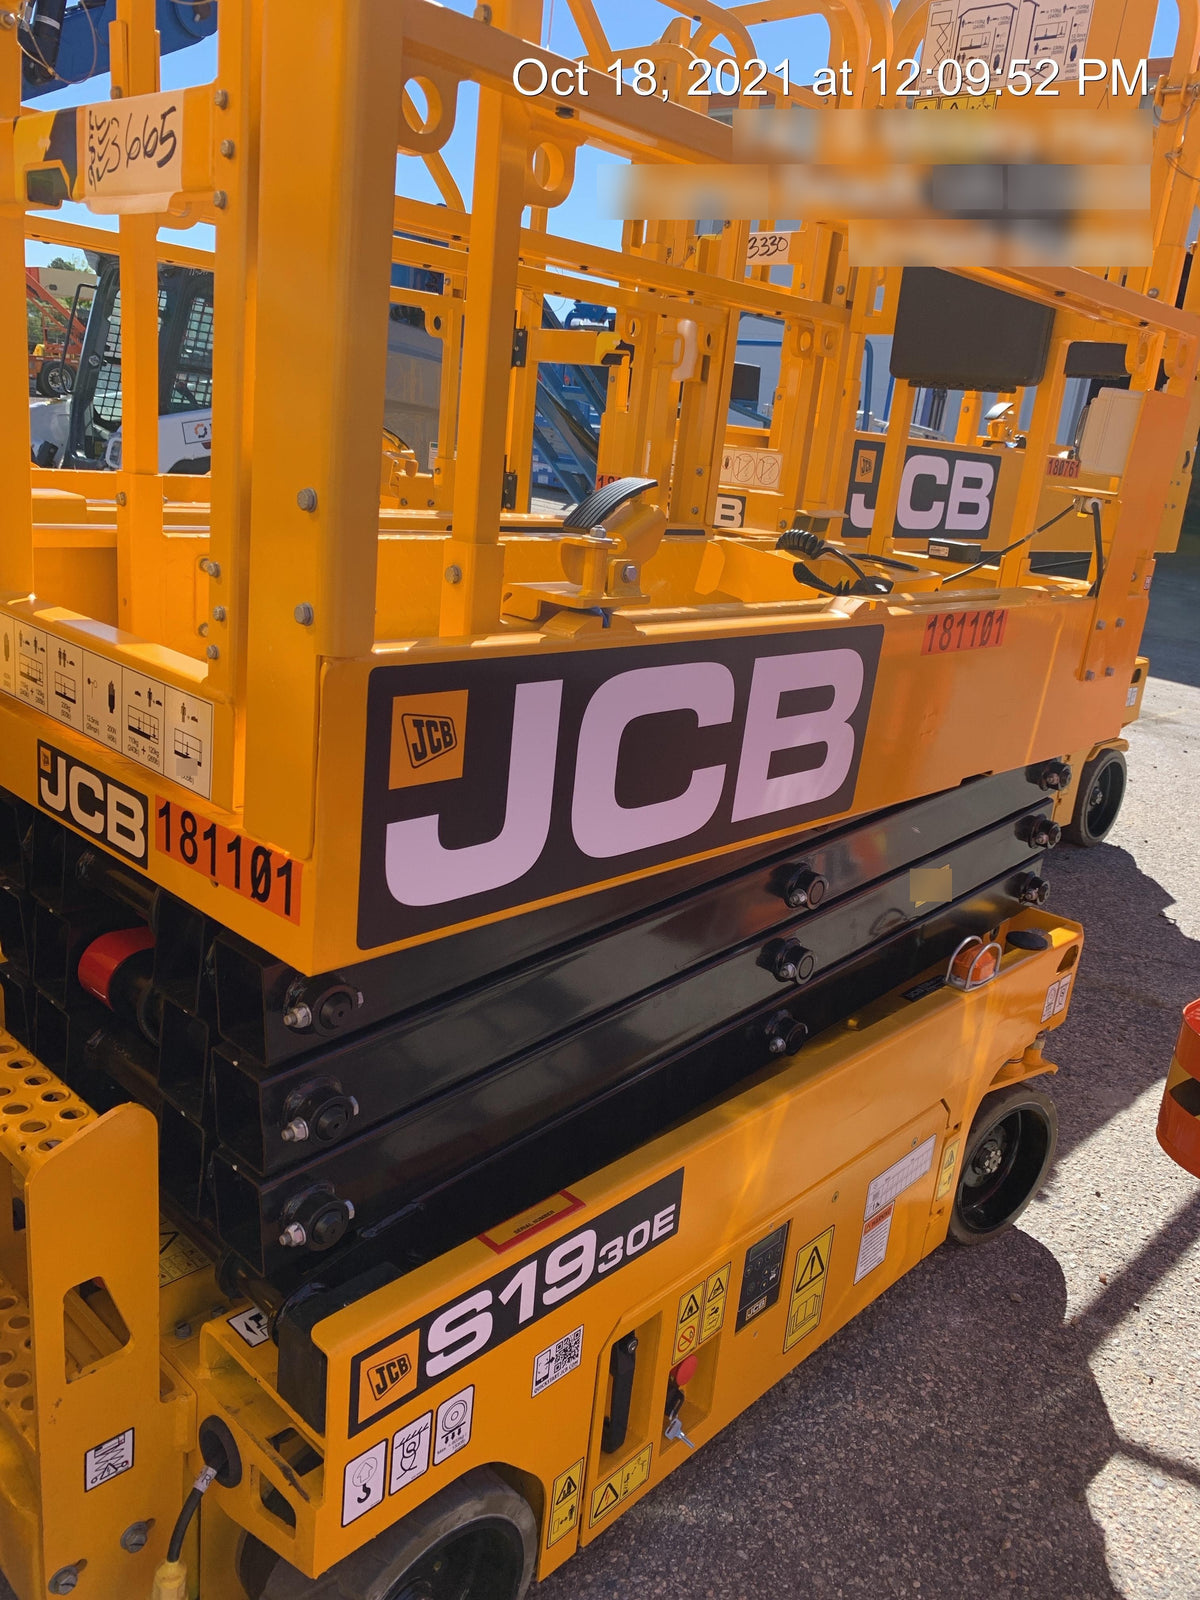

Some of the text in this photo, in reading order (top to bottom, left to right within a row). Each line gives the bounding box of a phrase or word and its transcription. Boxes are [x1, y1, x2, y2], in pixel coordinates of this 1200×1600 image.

[747, 235, 789, 259] 3330
[1048, 458, 1081, 479] 180761
[927, 610, 1006, 652] 181101
[411, 717, 454, 762] JCB
[385, 648, 865, 907] JCB
[40, 756, 146, 859] JCB
[158, 801, 293, 916] 181101
[513, 1209, 556, 1235] SERIAL NUMBER
[747, 1298, 766, 1318] JCB
[375, 1356, 409, 1395] JCB
